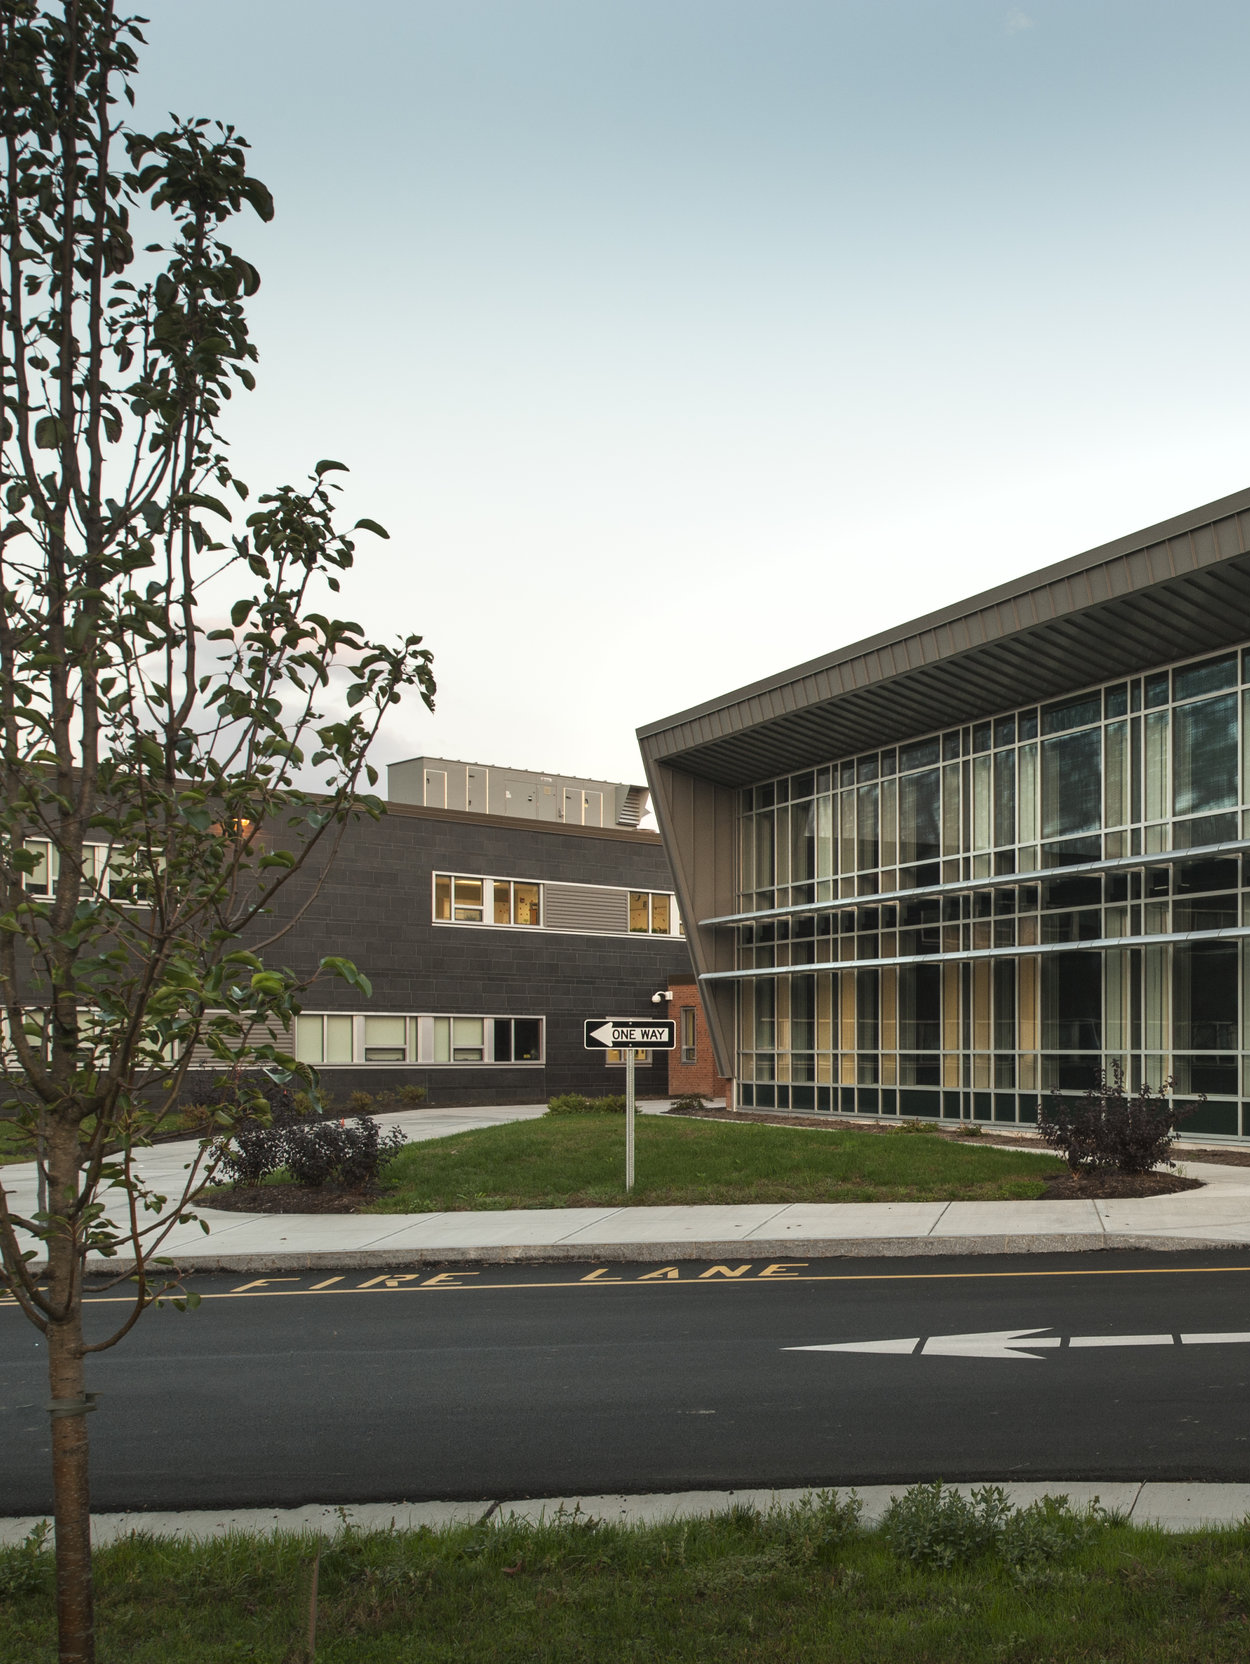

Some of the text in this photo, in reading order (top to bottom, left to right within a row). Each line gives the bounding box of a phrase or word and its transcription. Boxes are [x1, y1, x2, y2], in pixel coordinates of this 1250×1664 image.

[612, 1029, 665, 1040] ONE WAY
[230, 1263, 809, 1292] FIRE LANE
